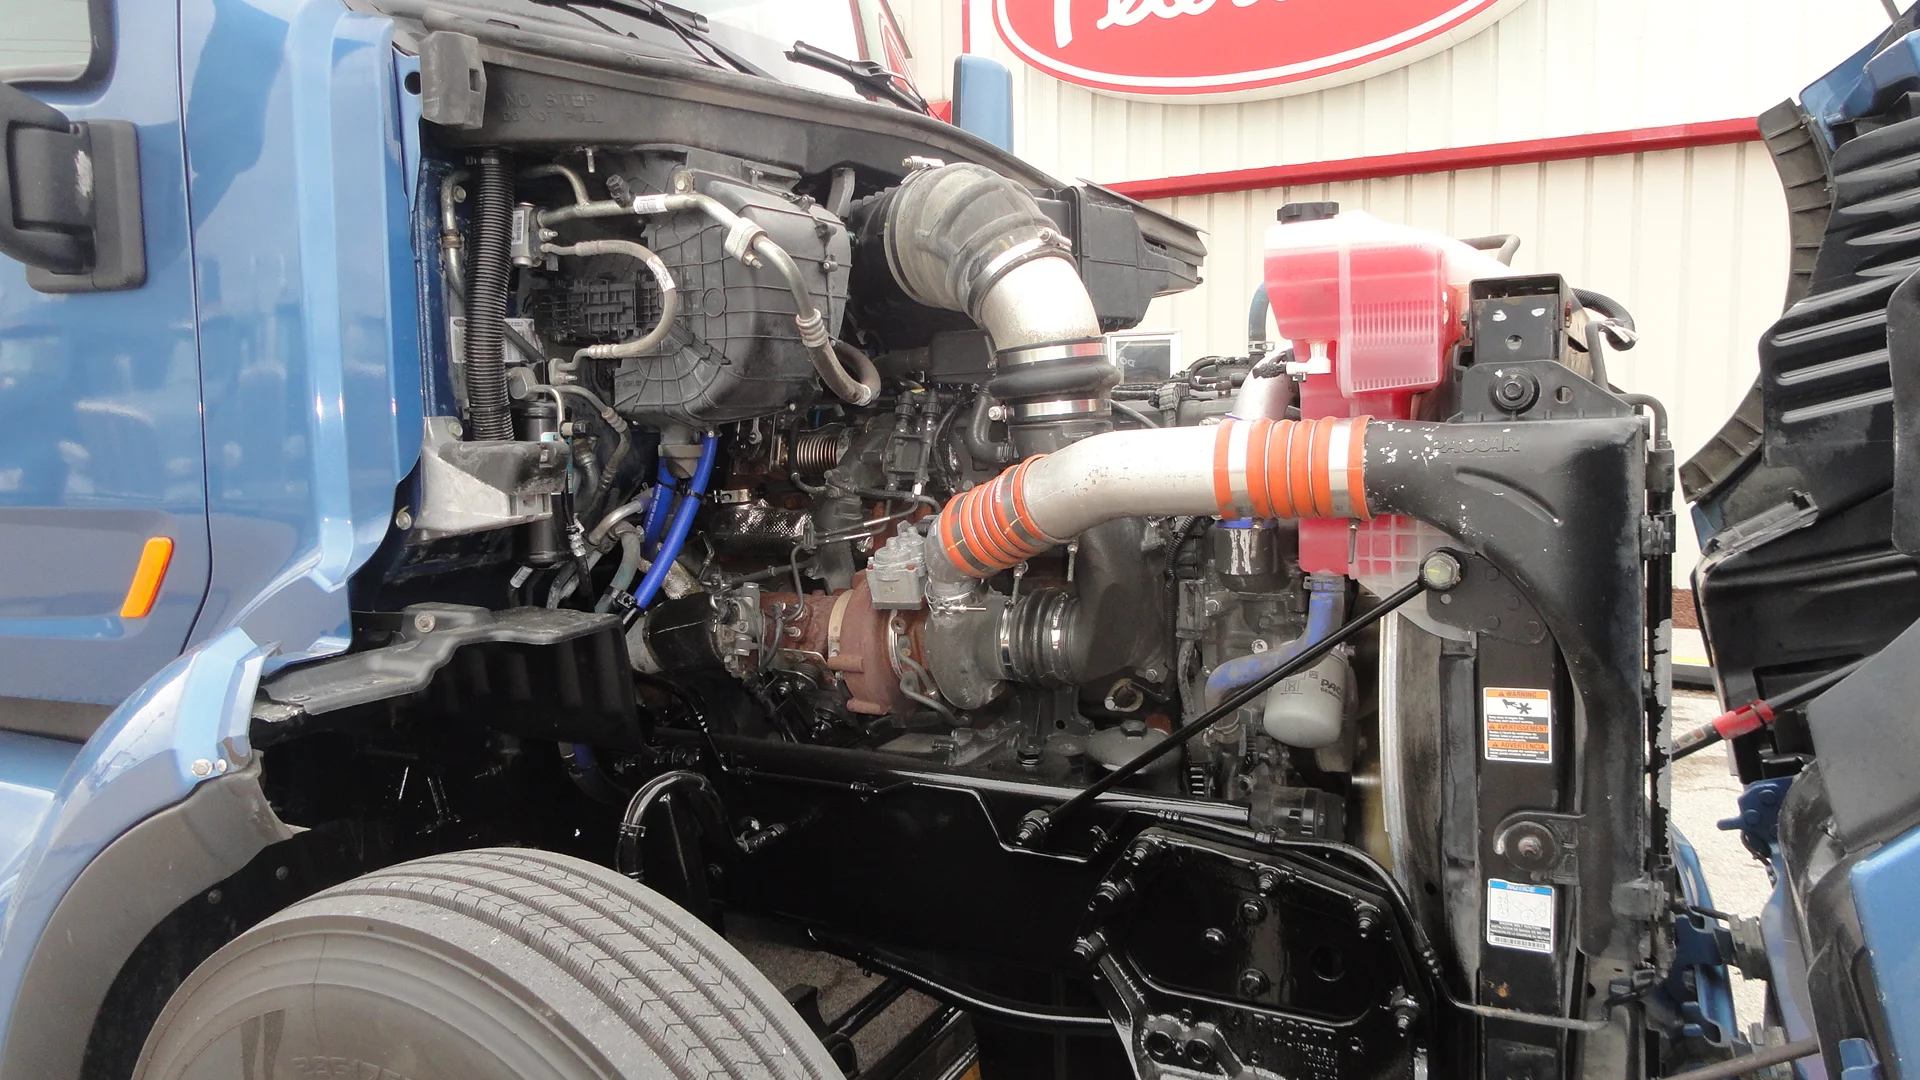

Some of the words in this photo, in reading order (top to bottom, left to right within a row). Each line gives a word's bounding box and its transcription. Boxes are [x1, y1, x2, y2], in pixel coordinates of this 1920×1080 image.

[505, 92, 530, 107] NO
[545, 92, 597, 107] STEP
[1430, 436, 1521, 453] PACCAR
[1506, 691, 1537, 699] WARNING
[1497, 724, 1548, 732] AVERTISSEMENT
[1501, 742, 1546, 750] ADVERTENCIA
[1507, 884, 1536, 892] NOTICE
